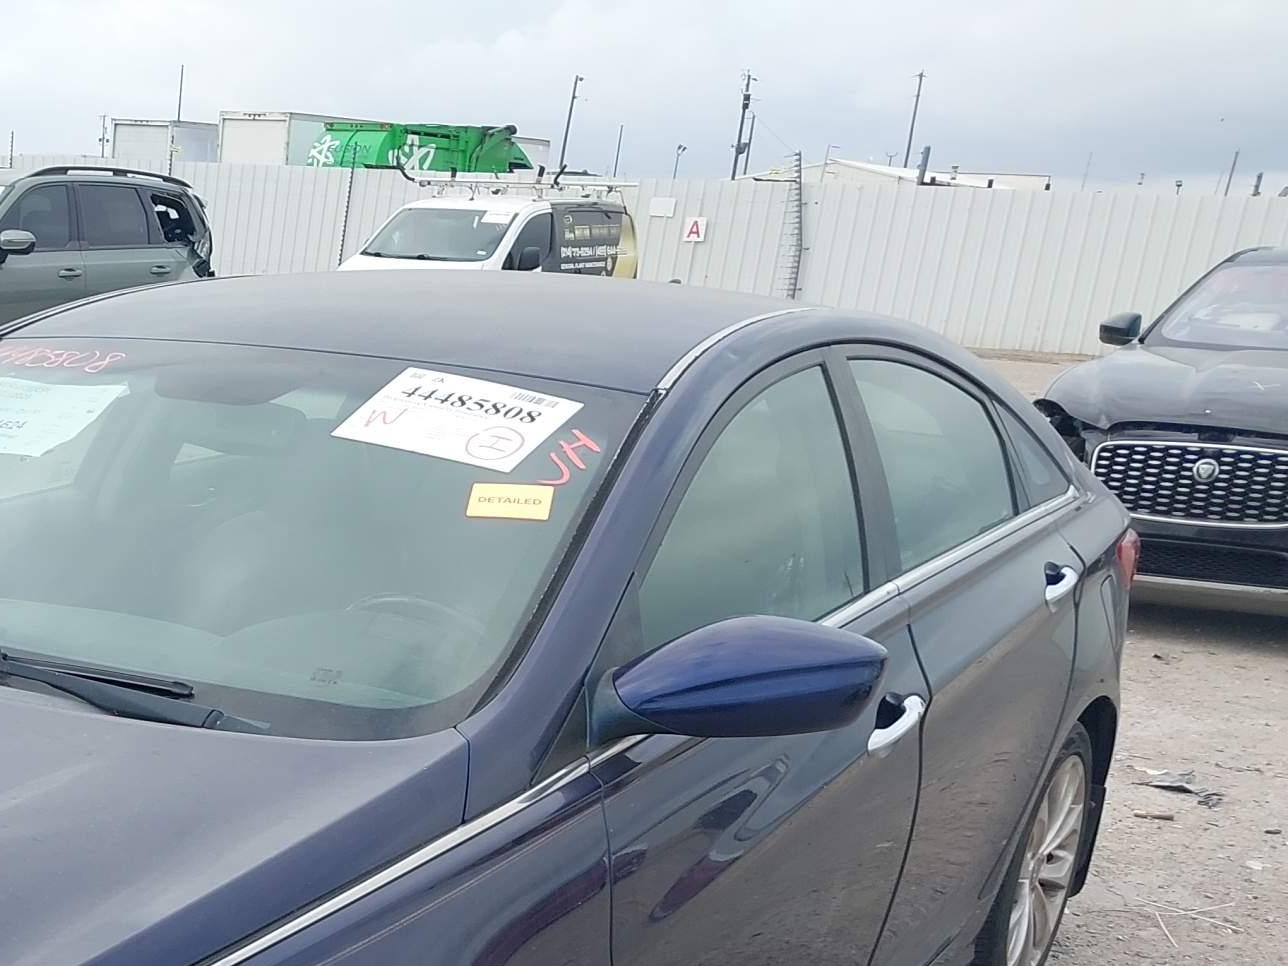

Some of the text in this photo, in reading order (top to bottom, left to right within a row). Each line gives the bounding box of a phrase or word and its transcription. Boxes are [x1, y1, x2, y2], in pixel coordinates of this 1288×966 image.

[686, 220, 701, 238] A
[401, 385, 543, 424] 44485808
[477, 495, 543, 506] DETAILED
